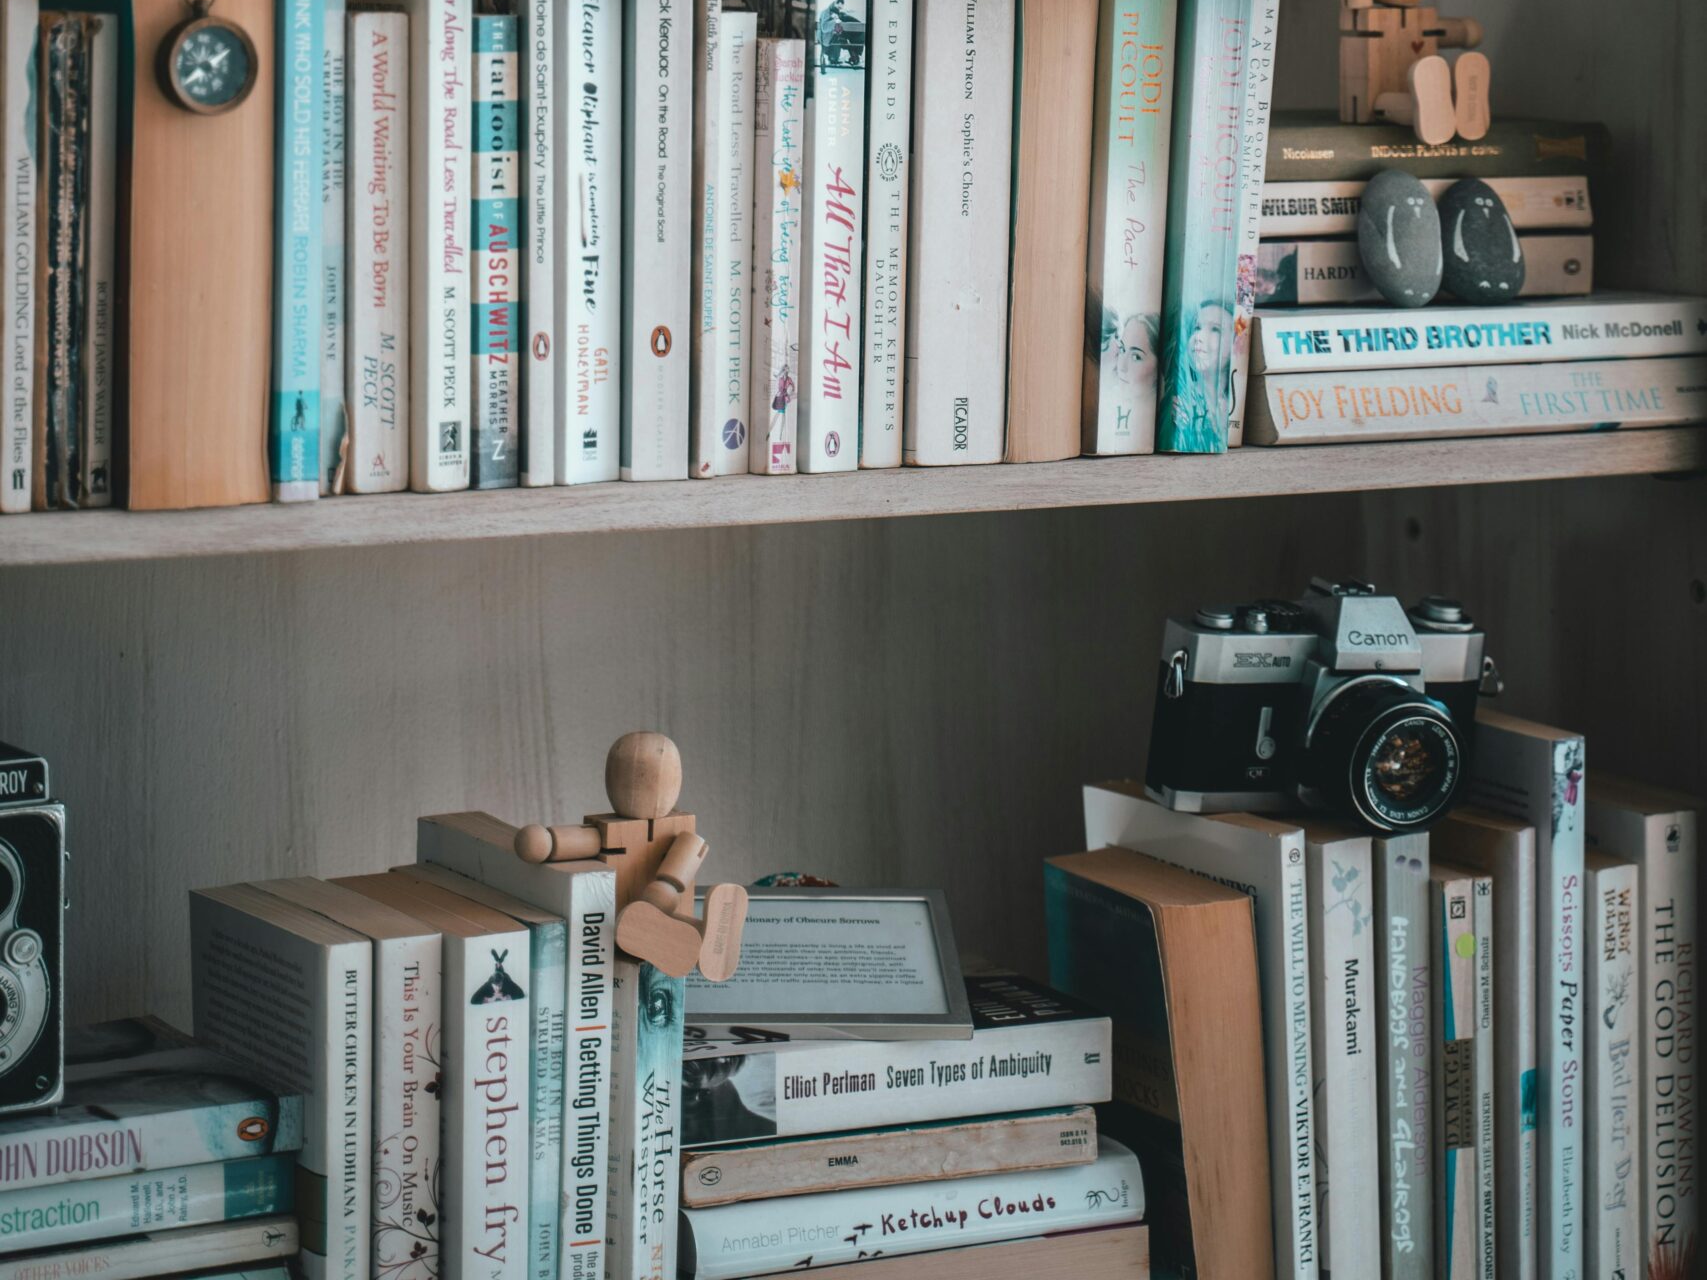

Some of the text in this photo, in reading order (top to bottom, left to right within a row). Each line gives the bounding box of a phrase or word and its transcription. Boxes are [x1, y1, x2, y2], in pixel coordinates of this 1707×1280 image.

[294, 32, 312, 75] WHO
[535, 39, 549, 62] de
[886, 19, 900, 121] EDWARDS
[964, 49, 978, 100] STYRON
[1117, 10, 1140, 147] PICOULT
[1140, 43, 1165, 114] JODI
[293, 78, 312, 126] SOLD
[533, 63, 551, 167] Saint-Exupéry
[1239, 36, 1263, 191] A CAST OF SMILES
[293, 126, 310, 157] HIS
[728, 31, 745, 243] The Road Less Travelled
[961, 112, 977, 167] Sophie's
[487, 21, 512, 366] THE tattooist OF AUSCHWITZ
[536, 174, 547, 195] The
[536, 197, 547, 224] Little
[889, 190, 901, 232] THE
[960, 170, 975, 217] Choice
[536, 226, 548, 264] Prince
[822, 162, 858, 400] All That I Am
[873, 258, 885, 365] DAUGHTER
[887, 246, 899, 327] MEMORY
[442, 286, 457, 408] M. SCOTT PECK
[727, 259, 742, 406] M. SCOTT PECK
[1276, 320, 1553, 357] THE THIRD BROTHER
[1561, 319, 1684, 341] Nick McDonell
[362, 354, 380, 408] PECK
[378, 331, 396, 430] M. SCOTT
[488, 370, 498, 425] MORRIS
[498, 369, 509, 434] HEATHER
[884, 338, 897, 432] KEEPER'S
[1276, 382, 1463, 430] JOY FIELDING
[1518, 386, 1665, 417] FIRST TIME
[1569, 370, 1602, 388] THE
[953, 396, 969, 452] PICADOR
[1347, 630, 1408, 647] Canon
[1603, 888, 1617, 962] HOLDEN
[1617, 888, 1632, 955] WENDY
[1344, 958, 1362, 1056] Murakami
[401, 960, 421, 1229] This Is Your Brain On Music
[571, 911, 606, 1269] David Allen Getting Things Done the
[783, 1050, 1052, 1102] Elliot Perlman Seven Types of Ambiguity
[1289, 878, 1313, 1271] THE WILL TO MEANING VIKTOR E. FRANKL
[1558, 874, 1580, 1255] Scissors Paper Stone Elizabeth Day
[1654, 897, 1677, 1247] THE GOD DELUSION
[46, 1127, 143, 1177] DOBSON
[472, 1015, 520, 1266] stephen fry
[637, 1068, 656, 1246] Whisperer
[652, 1080, 674, 1224] The Horse
[827, 1155, 859, 1168] EMMA
